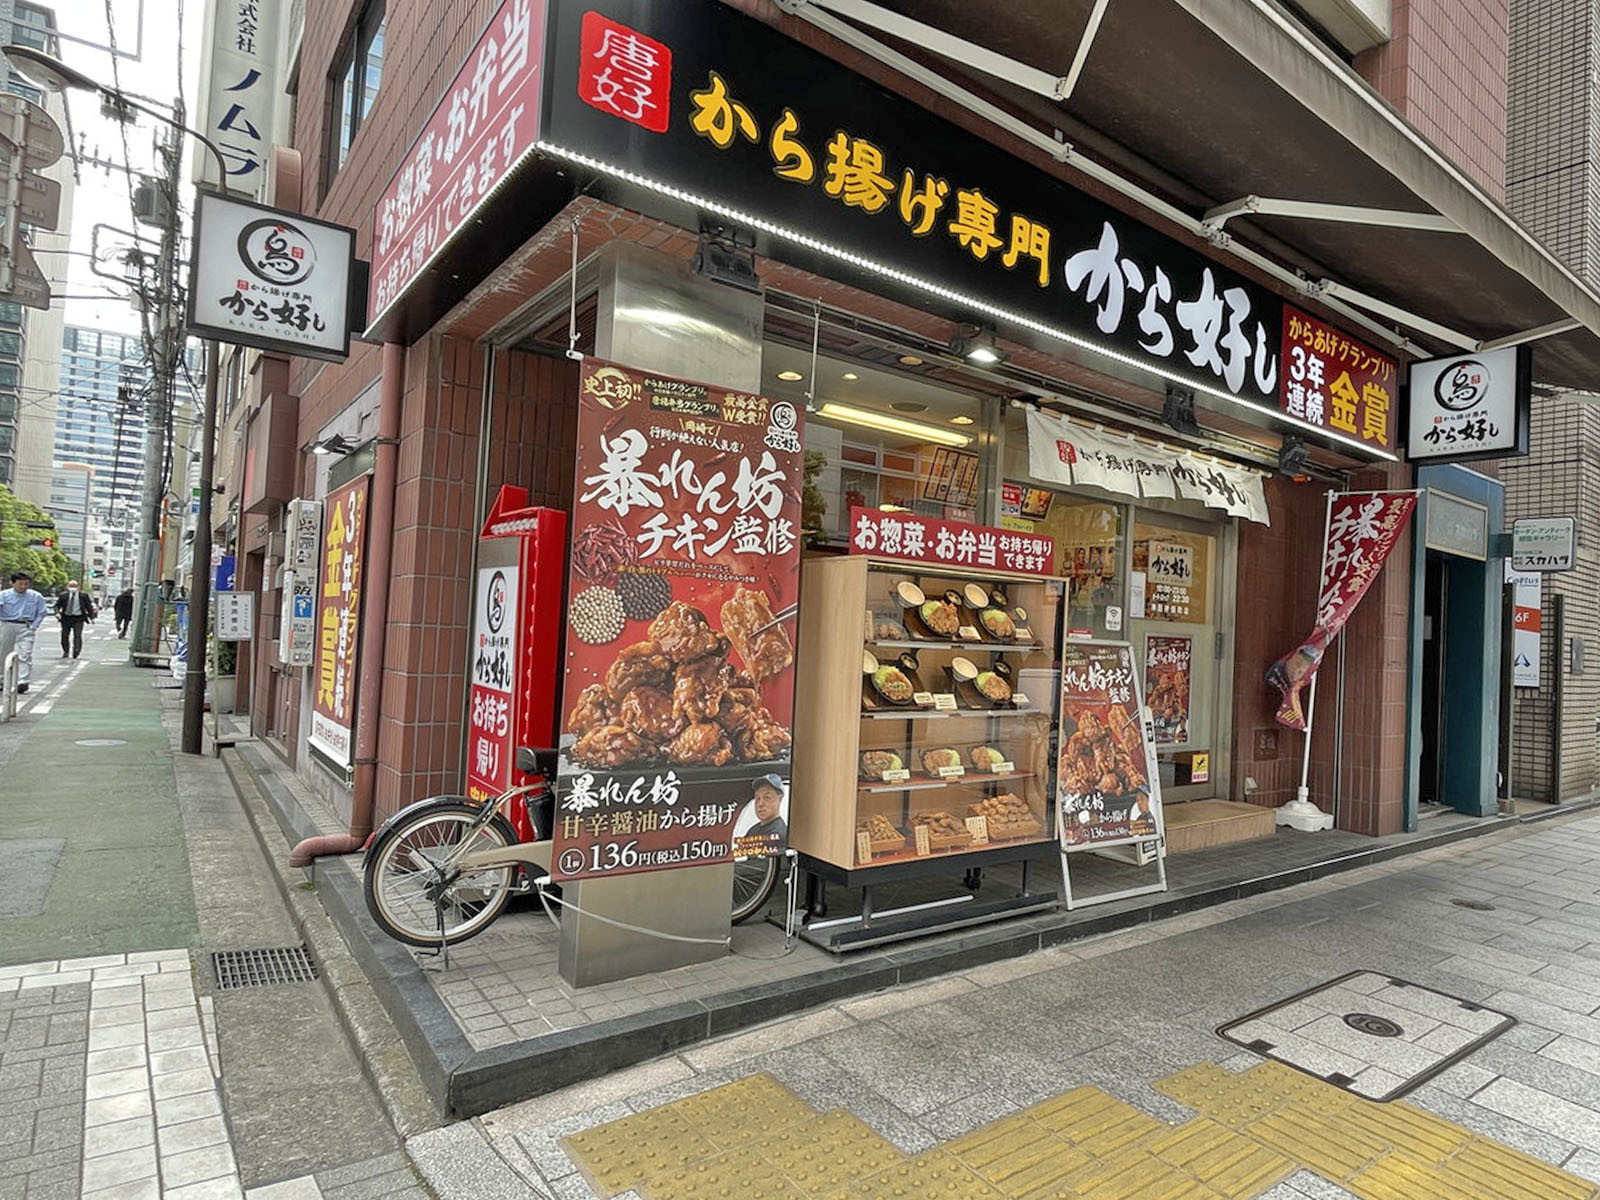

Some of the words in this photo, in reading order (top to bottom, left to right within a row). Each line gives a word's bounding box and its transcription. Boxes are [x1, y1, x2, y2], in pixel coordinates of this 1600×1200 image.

[235, 0, 258, 55] 式会社
[217, 69, 262, 175] ノムラ
[378, 0, 531, 255] お惣菜・お弁当
[690, 71, 1051, 288] から揚げ専門
[376, 102, 524, 314] お持ち帰りできます
[219, 290, 325, 332] から好し
[1064, 221, 1276, 394] から好し
[1288, 316, 1391, 381] からあげグランプリ
[1289, 346, 1326, 388] 3年
[1286, 380, 1325, 426] 連続
[1329, 370, 1391, 446] 金賞
[1423, 418, 1499, 444] から好し
[580, 429, 787, 519] 暴れん坊
[1173, 458, 1247, 506] から好し
[636, 512, 797, 560] チキン監修
[854, 514, 997, 566] お惣菜・お弁当
[998, 535, 1052, 556] お持ち帰り
[1003, 552, 1046, 572] できます
[1151, 556, 1191, 578] から好し
[318, 500, 347, 712] 金賞
[476, 650, 511, 688] から好し
[473, 690, 508, 736] お持ち
[477, 736, 499, 781] 帰り
[561, 769, 682, 813] 暴れん坊
[560, 802, 738, 840] 甘辛醤油から揚げ
